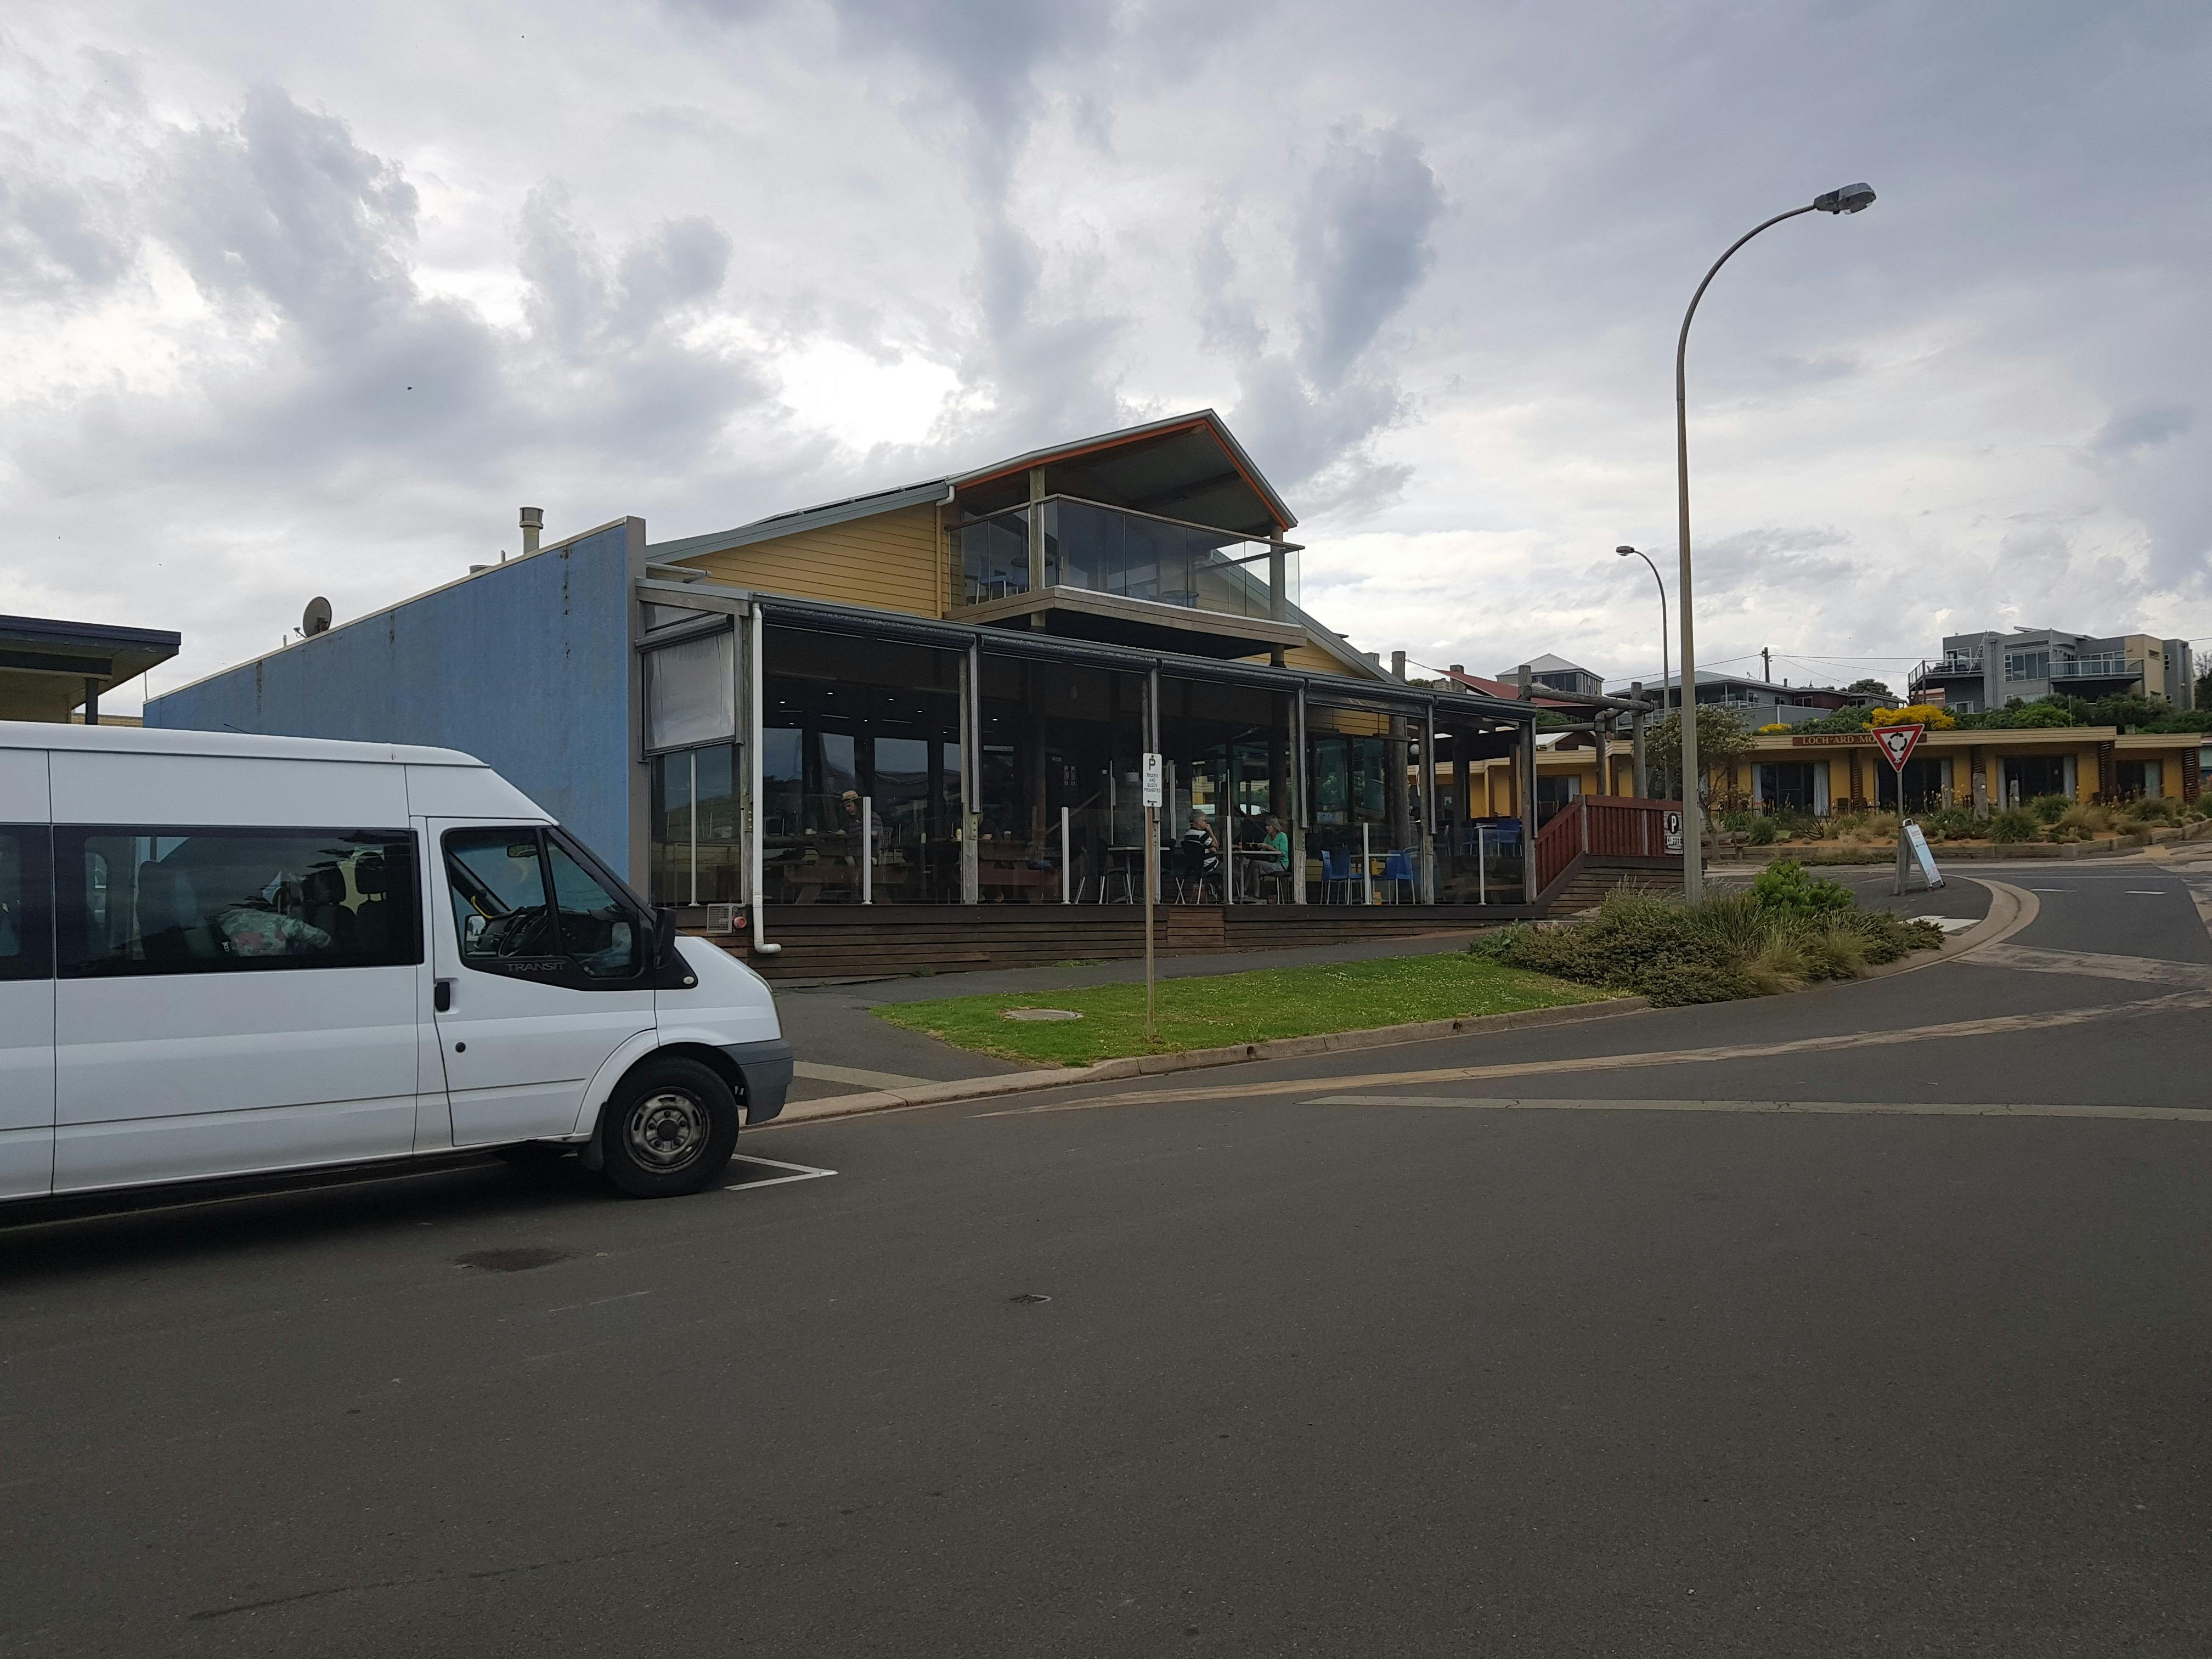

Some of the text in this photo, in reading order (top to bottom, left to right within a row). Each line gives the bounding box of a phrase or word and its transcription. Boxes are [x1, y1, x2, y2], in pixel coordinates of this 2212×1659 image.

[1149, 758, 1156, 770] P
[1671, 815, 1677, 832] P
[1666, 837, 1681, 845] COFFEE
[506, 962, 565, 972] TRANSIT
